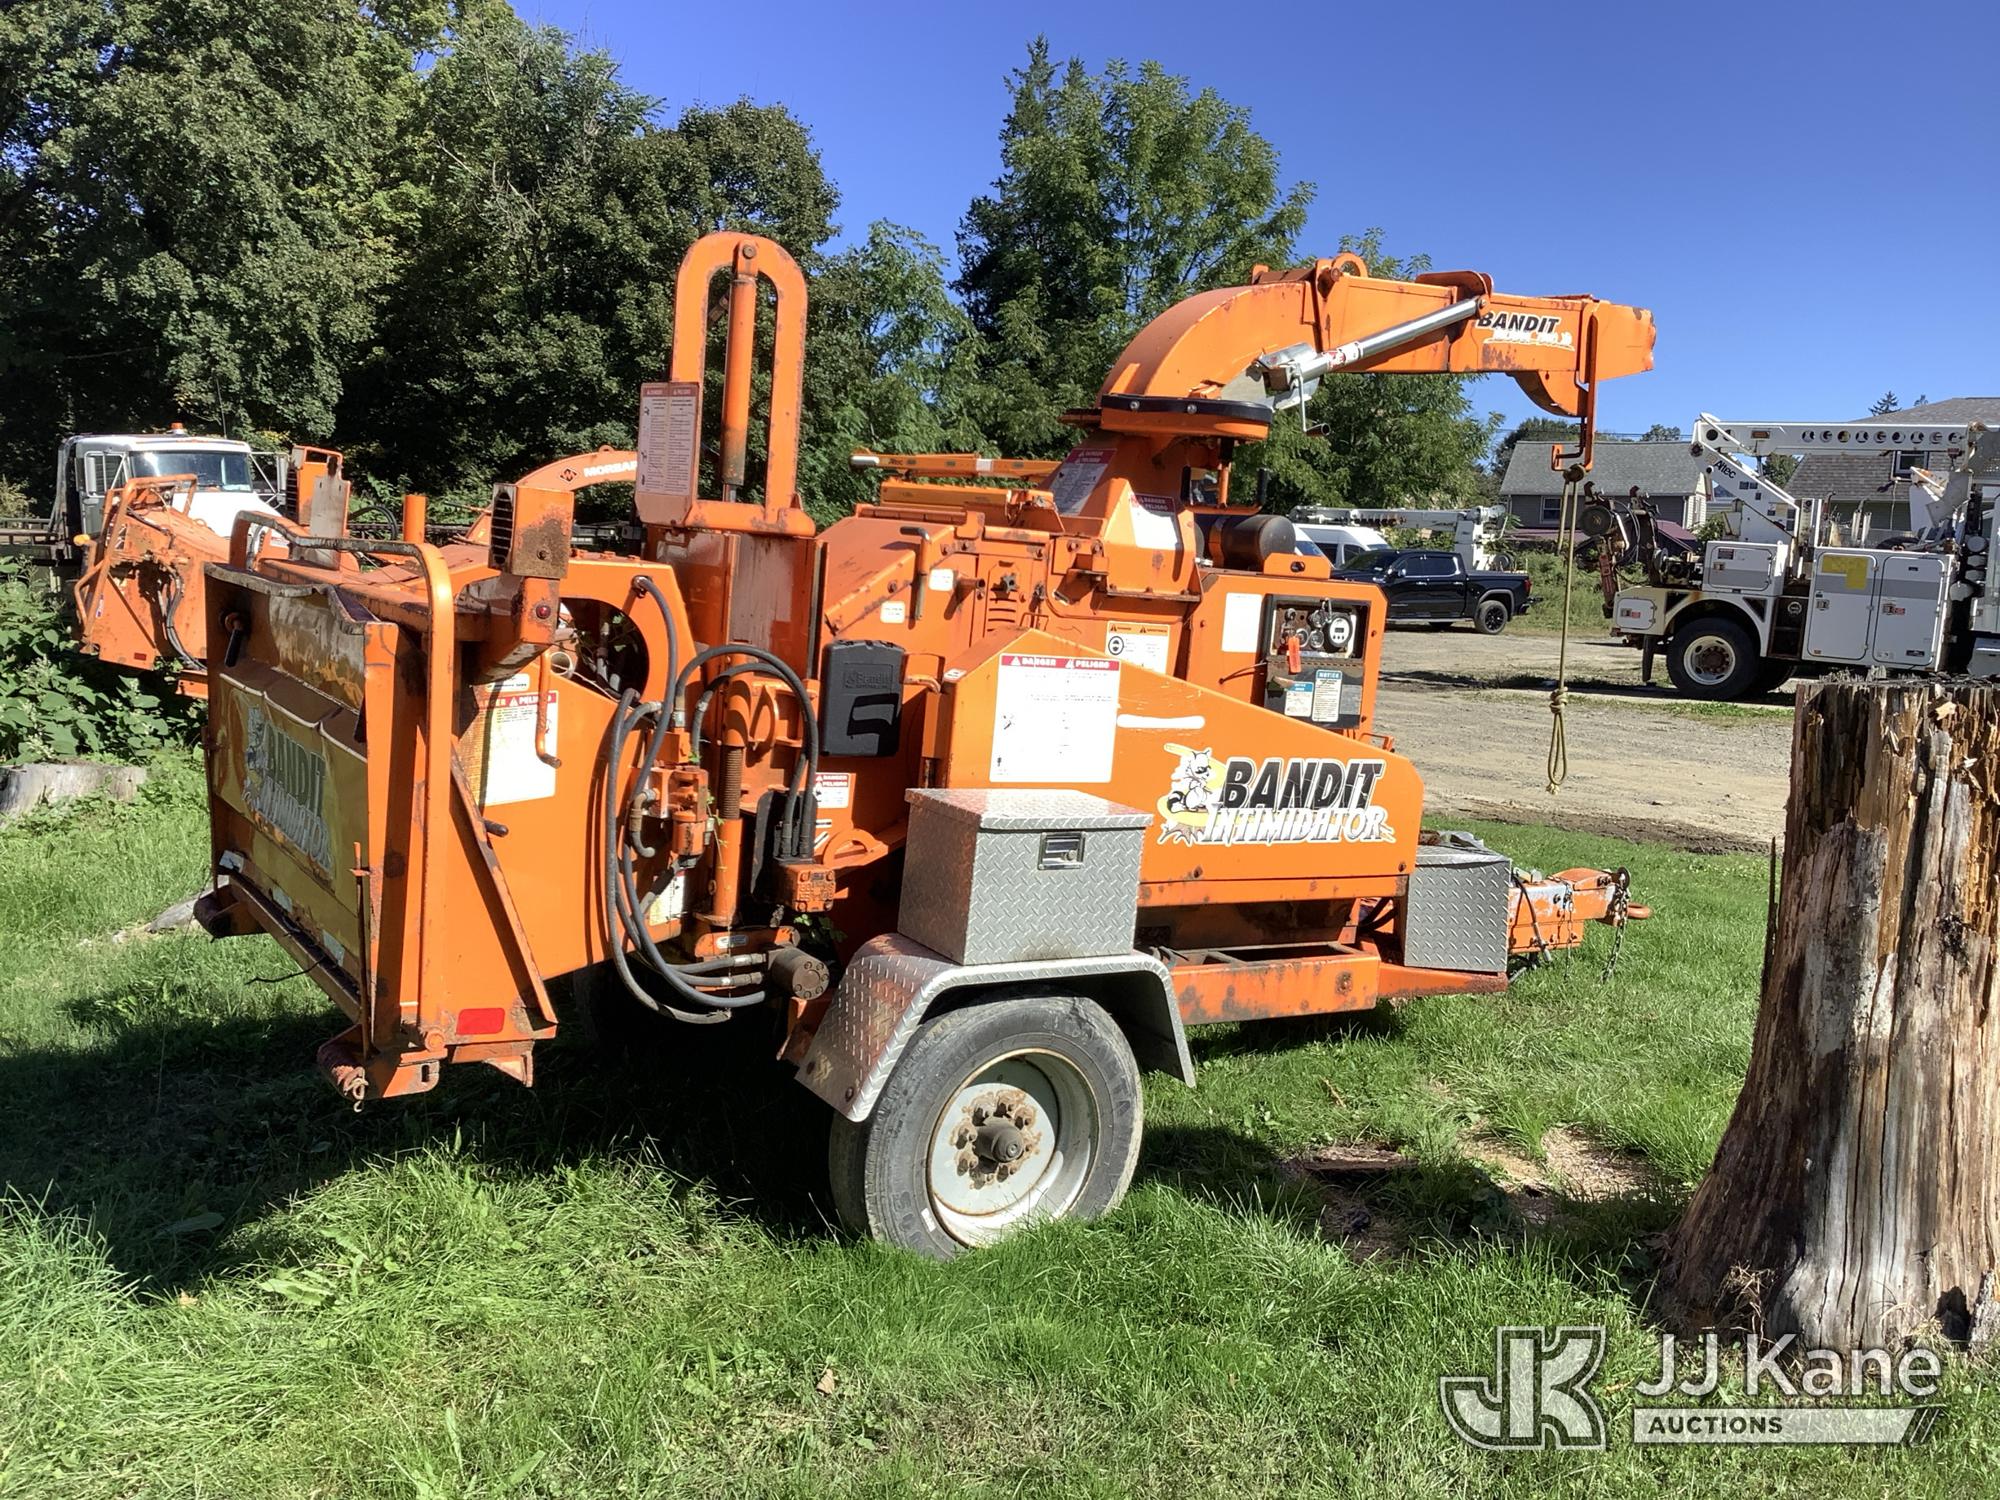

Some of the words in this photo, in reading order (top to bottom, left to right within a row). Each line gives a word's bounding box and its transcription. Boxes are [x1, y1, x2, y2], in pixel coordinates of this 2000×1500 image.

[1477, 311, 1560, 333] BANDIT
[1714, 460, 1737, 479] Altec
[1021, 657, 1056, 667] DANGER
[1075, 660, 1109, 670] PELIGRO
[1220, 758, 1385, 812] BANDIT
[1202, 804, 1395, 844] INTIMIDATOR
